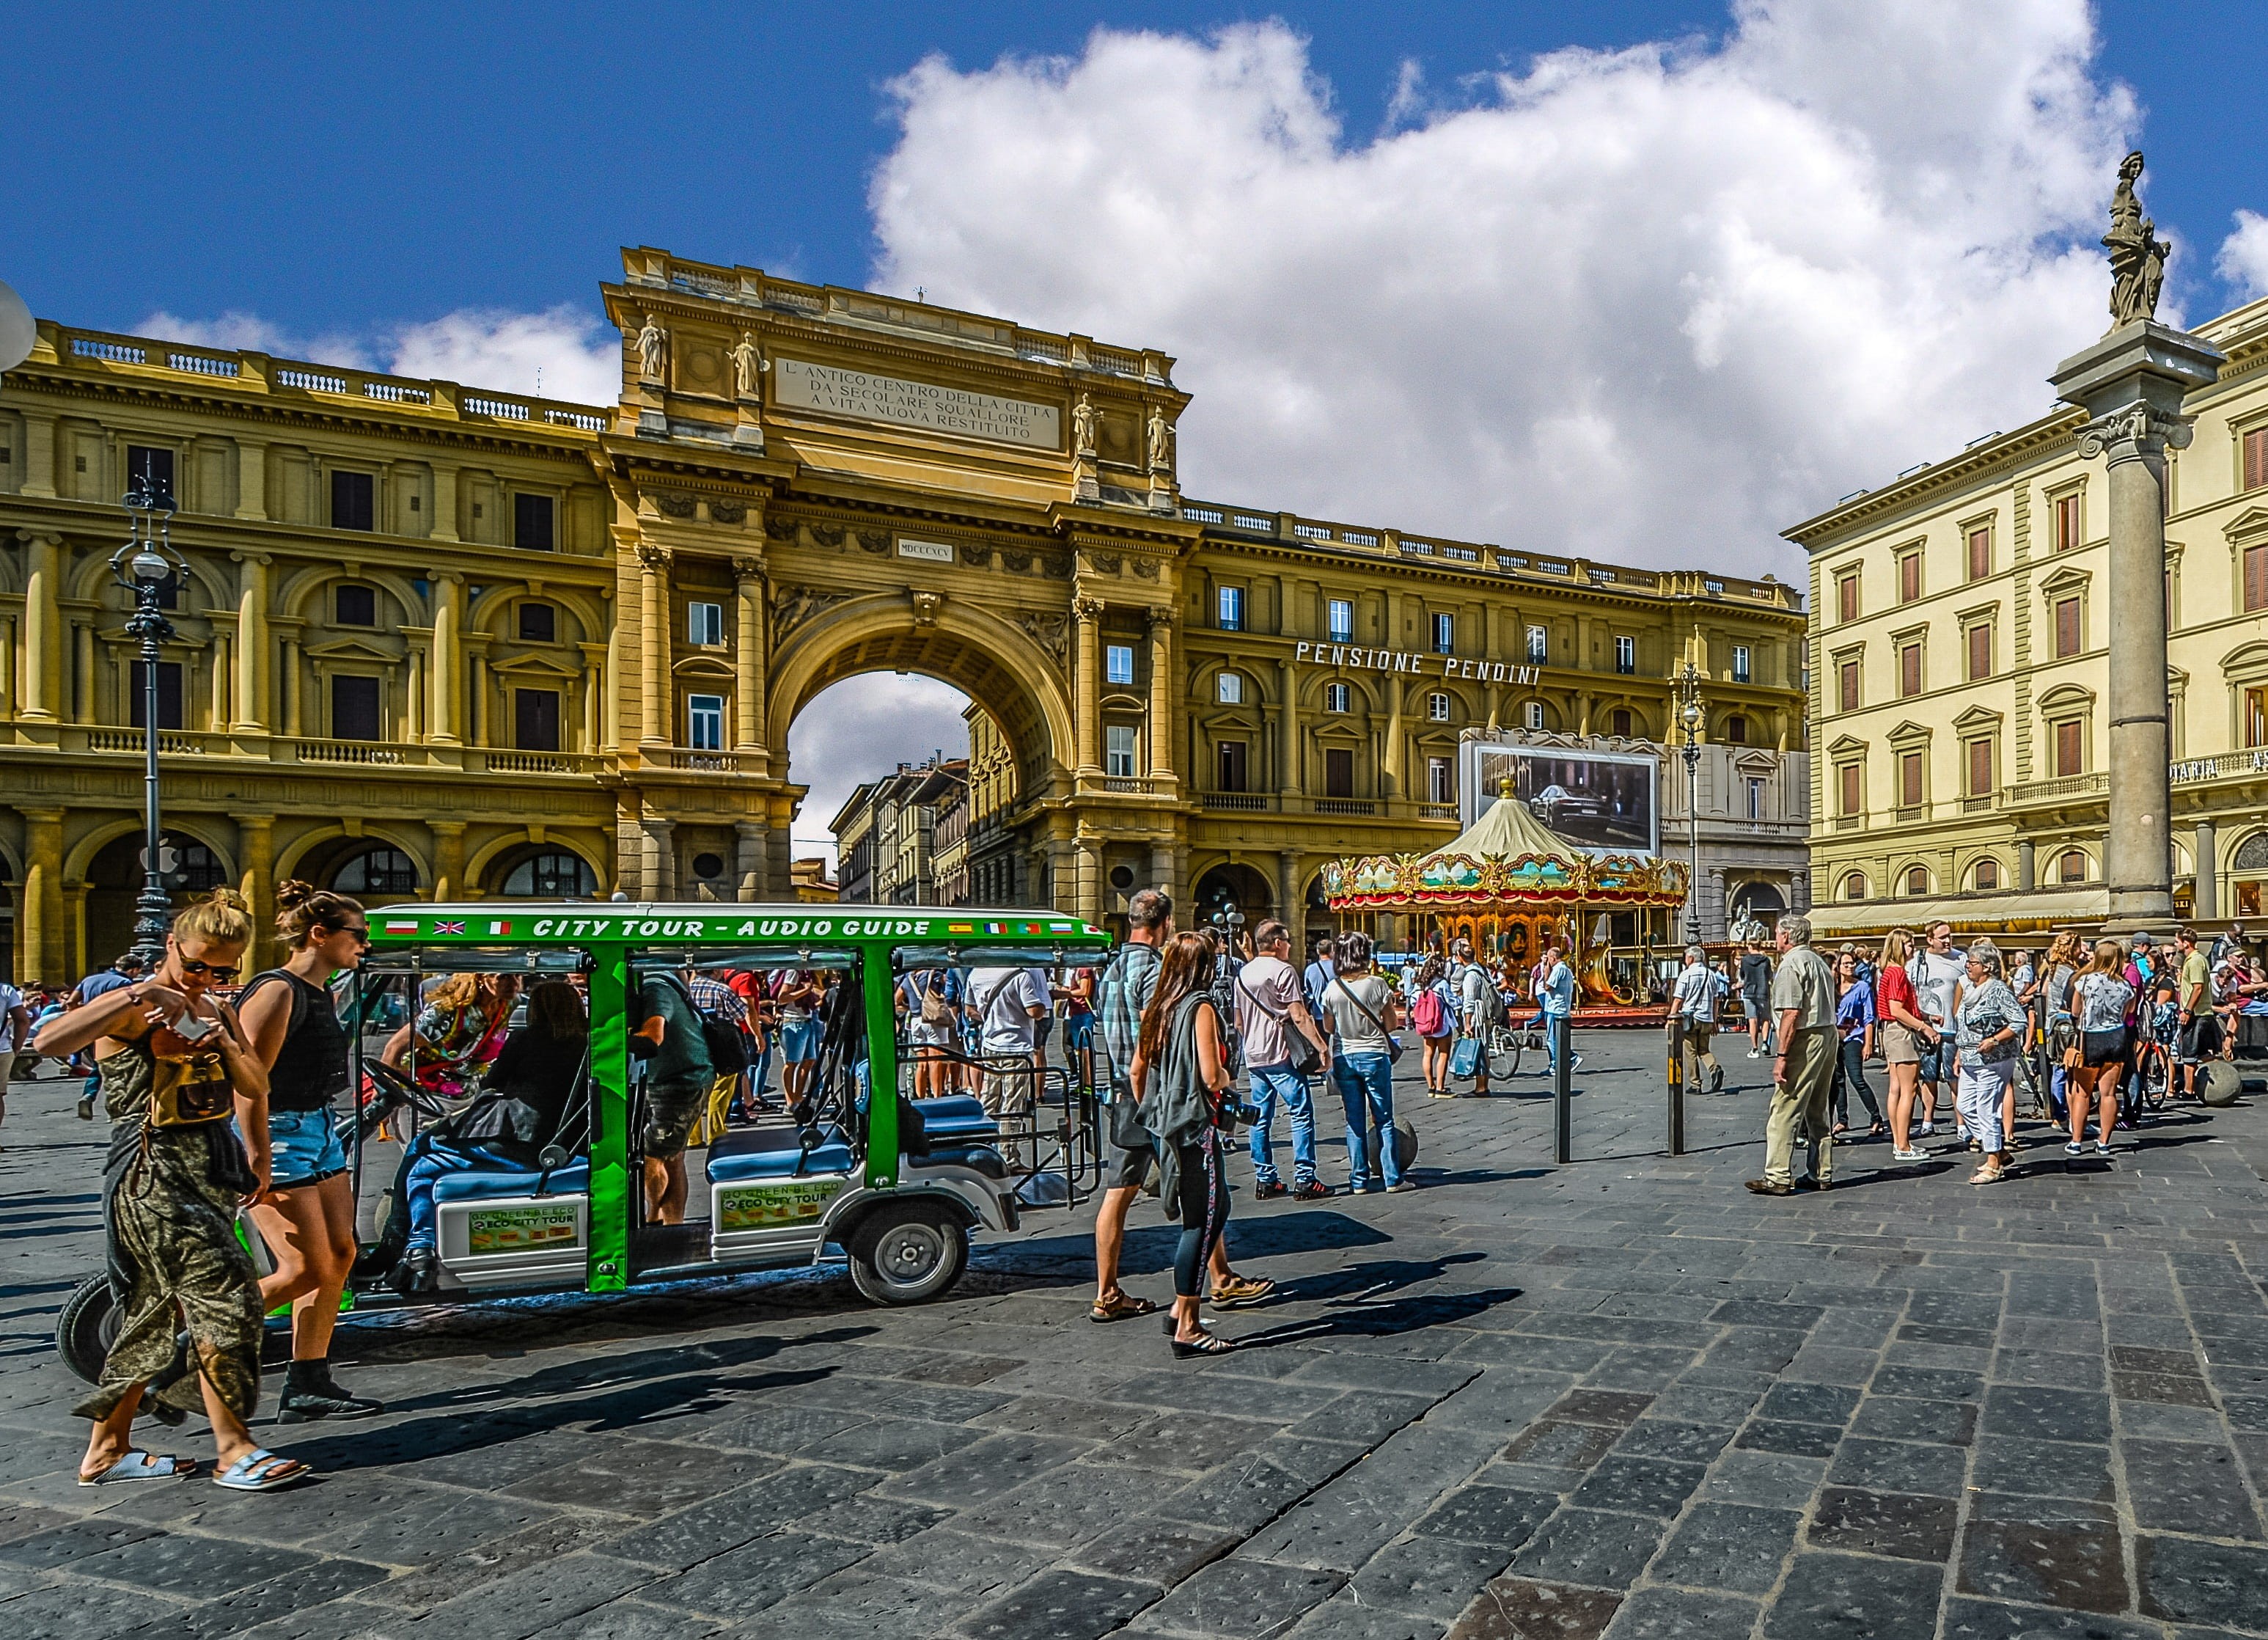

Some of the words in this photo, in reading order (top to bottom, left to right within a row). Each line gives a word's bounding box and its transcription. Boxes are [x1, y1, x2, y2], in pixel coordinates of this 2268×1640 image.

[805, 367, 866, 386] ANTICO
[873, 378, 939, 398] CENTRO
[945, 390, 999, 409] DELLA
[810, 380, 832, 393] DA
[840, 385, 928, 409] SECOLARE
[935, 402, 1030, 427] SQUALLORE
[811, 394, 821, 404] A
[829, 396, 867, 411] VITA
[875, 403, 930, 422] NUOVA
[937, 414, 1030, 439] RESTITUITO
[1296, 640, 1423, 674] PENSIONE
[1445, 657, 1540, 686] PENDINI
[532, 920, 610, 937] CITY
[621, 920, 704, 937] TOUR
[736, 920, 832, 937] AUDIO
[842, 920, 931, 937] GUIDE
[722, 1190, 741, 1199] GO
[746, 1185, 789, 1197] GREEN
[793, 1185, 809, 1194] BE
[814, 1182, 840, 1193] ECO
[738, 1198, 763, 1209] ECO
[766, 1196, 792, 1207] CITY
[795, 1193, 828, 1204] TOUR
[492, 1209, 530, 1219] GREEN
[552, 1207, 575, 1215] ECO
[487, 1219, 510, 1229] ECO
[514, 1218, 539, 1226] CITY
[542, 1215, 574, 1224] TOUR
